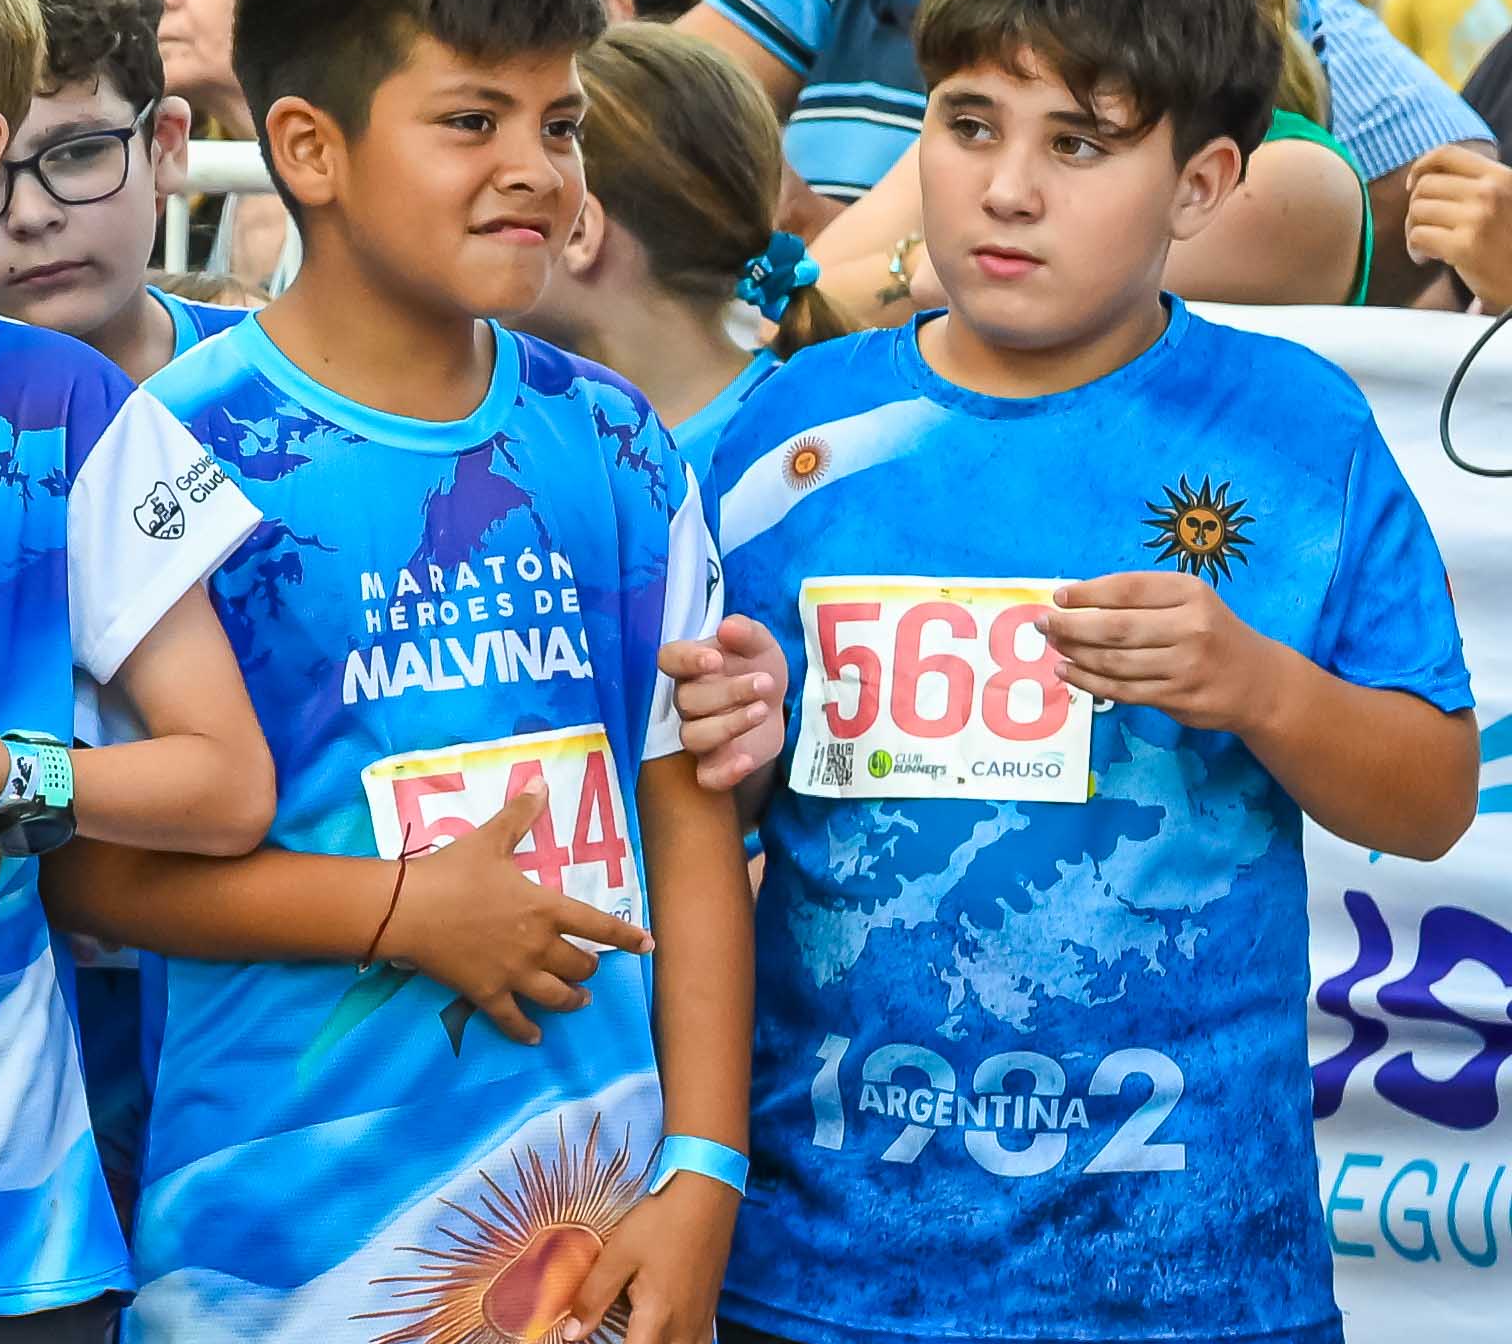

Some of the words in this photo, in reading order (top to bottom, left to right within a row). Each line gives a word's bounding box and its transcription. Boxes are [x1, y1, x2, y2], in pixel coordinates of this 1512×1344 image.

[360, 547, 575, 601] MARATÓN
[365, 593, 514, 634] HÉROES
[534, 588, 580, 615] DE
[816, 601, 1071, 741] 568
[894, 752, 923, 764] CLUB
[971, 760, 1062, 779] CARUSO
[392, 750, 627, 895] 544
[858, 1083, 1090, 1130] ARGENTINA
